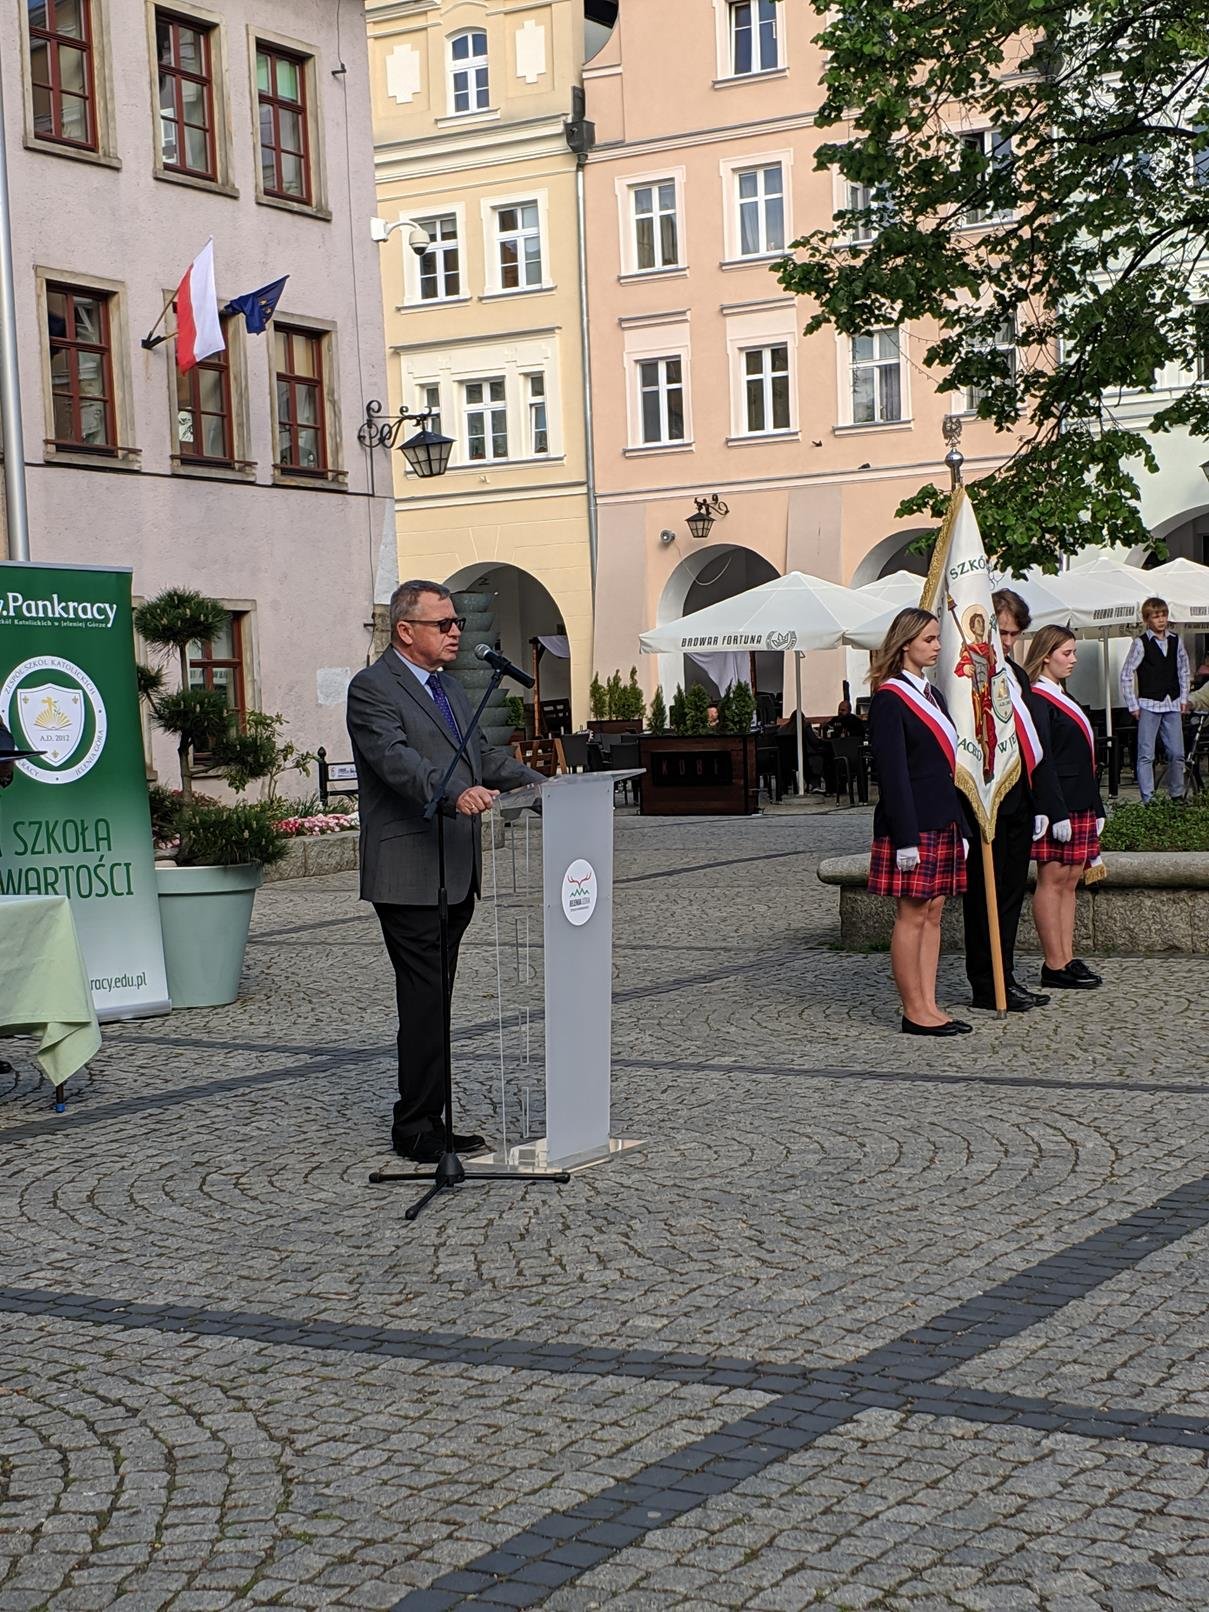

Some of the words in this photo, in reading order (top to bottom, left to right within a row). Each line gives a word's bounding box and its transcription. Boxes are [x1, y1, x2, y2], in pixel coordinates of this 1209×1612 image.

[949, 555, 987, 580] SZKÓ
[722, 634, 763, 645] FORTUNA
[13, 818, 112, 856] SZKOŁA
[0, 855, 134, 899] WARTOŚCI
[90, 971, 147, 992] racy.edu.pl
